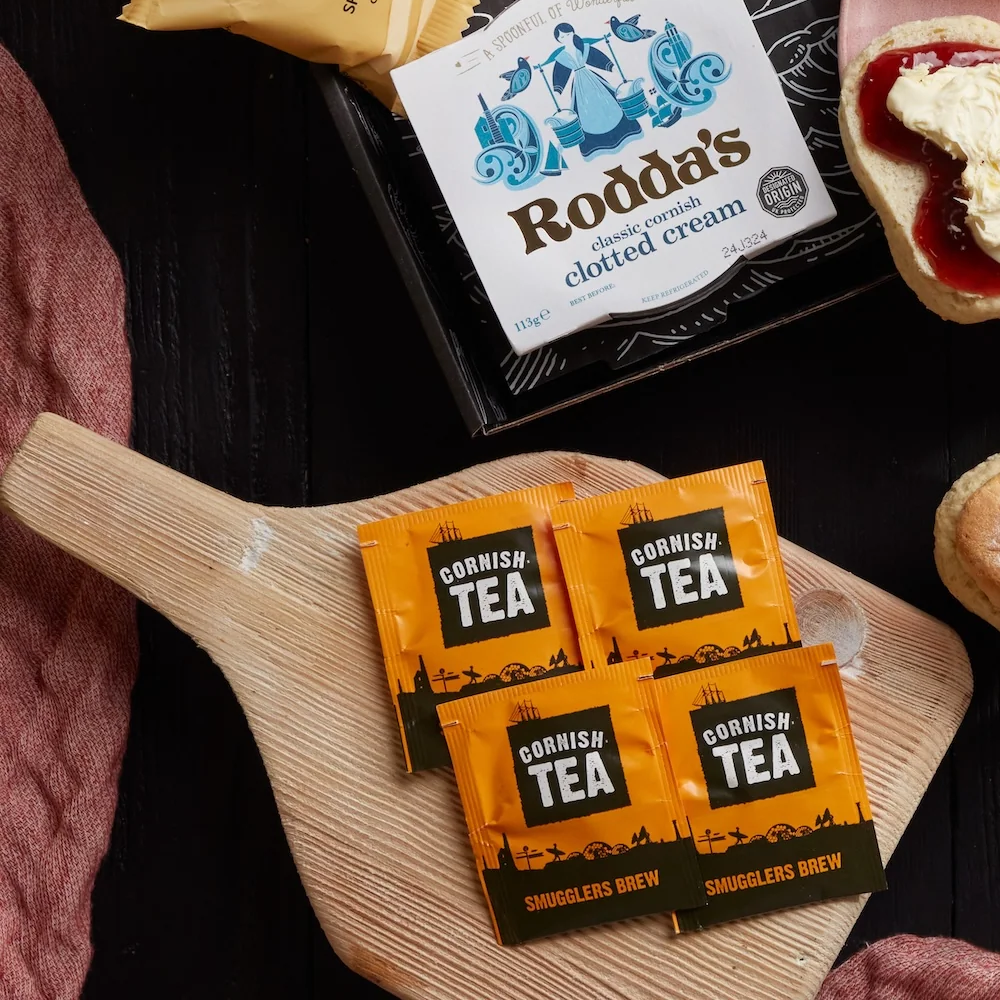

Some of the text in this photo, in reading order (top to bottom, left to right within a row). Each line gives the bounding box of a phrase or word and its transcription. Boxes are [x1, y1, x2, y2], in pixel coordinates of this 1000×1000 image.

[483, 49, 495, 61] A
[492, 12, 547, 52] SPOONFUL
[548, 2, 563, 20] OF
[507, 128, 751, 255] Rodda's
[762, 174, 796, 193] DESIGNATED
[764, 180, 803, 206] ORIGIN
[565, 199, 747, 287] clotted cream
[592, 196, 702, 251] classic cornish
[569, 295, 586, 306] BEST
[642, 270, 708, 303] KEEP REFRIGERATED
[440, 551, 525, 584] CORNISH
[631, 532, 717, 566] CORNISH
[449, 571, 535, 627] TEA
[640, 552, 728, 609] TEA
[519, 731, 603, 763] CORNISH
[703, 712, 790, 745] CORNISH
[528, 751, 615, 807] TEA
[712, 733, 800, 788] TEA
[525, 869, 659, 911] SMUGGLERS BREW
[705, 852, 841, 895] SMUGGLERS BREW
